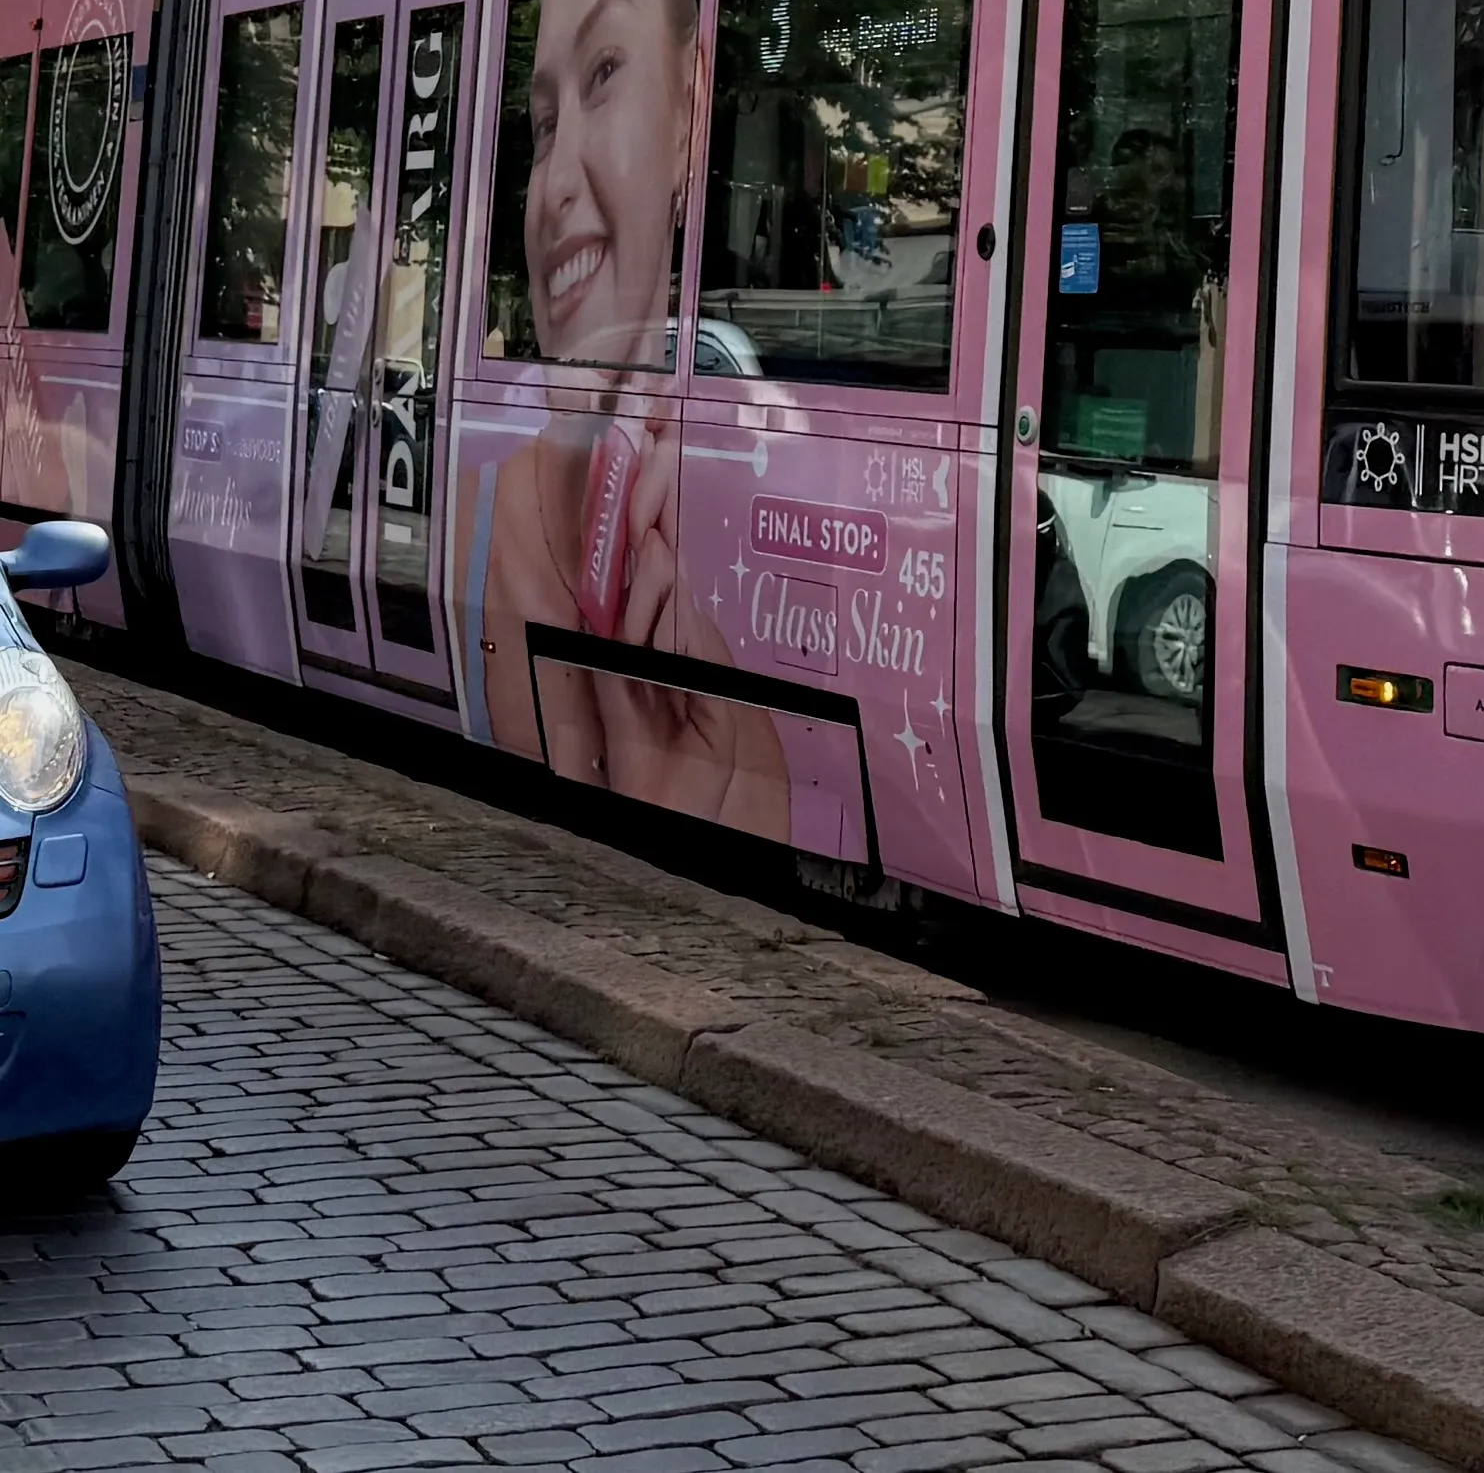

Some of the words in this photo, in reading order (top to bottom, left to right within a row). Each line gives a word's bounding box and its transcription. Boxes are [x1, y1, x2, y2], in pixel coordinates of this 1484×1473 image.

[901, 456, 927, 481] HSL
[758, 509, 813, 548] FINAL
[819, 518, 879, 560] STOP:
[899, 547, 946, 600] 455
[750, 571, 838, 656] Glass
[845, 587, 925, 676] Skin
